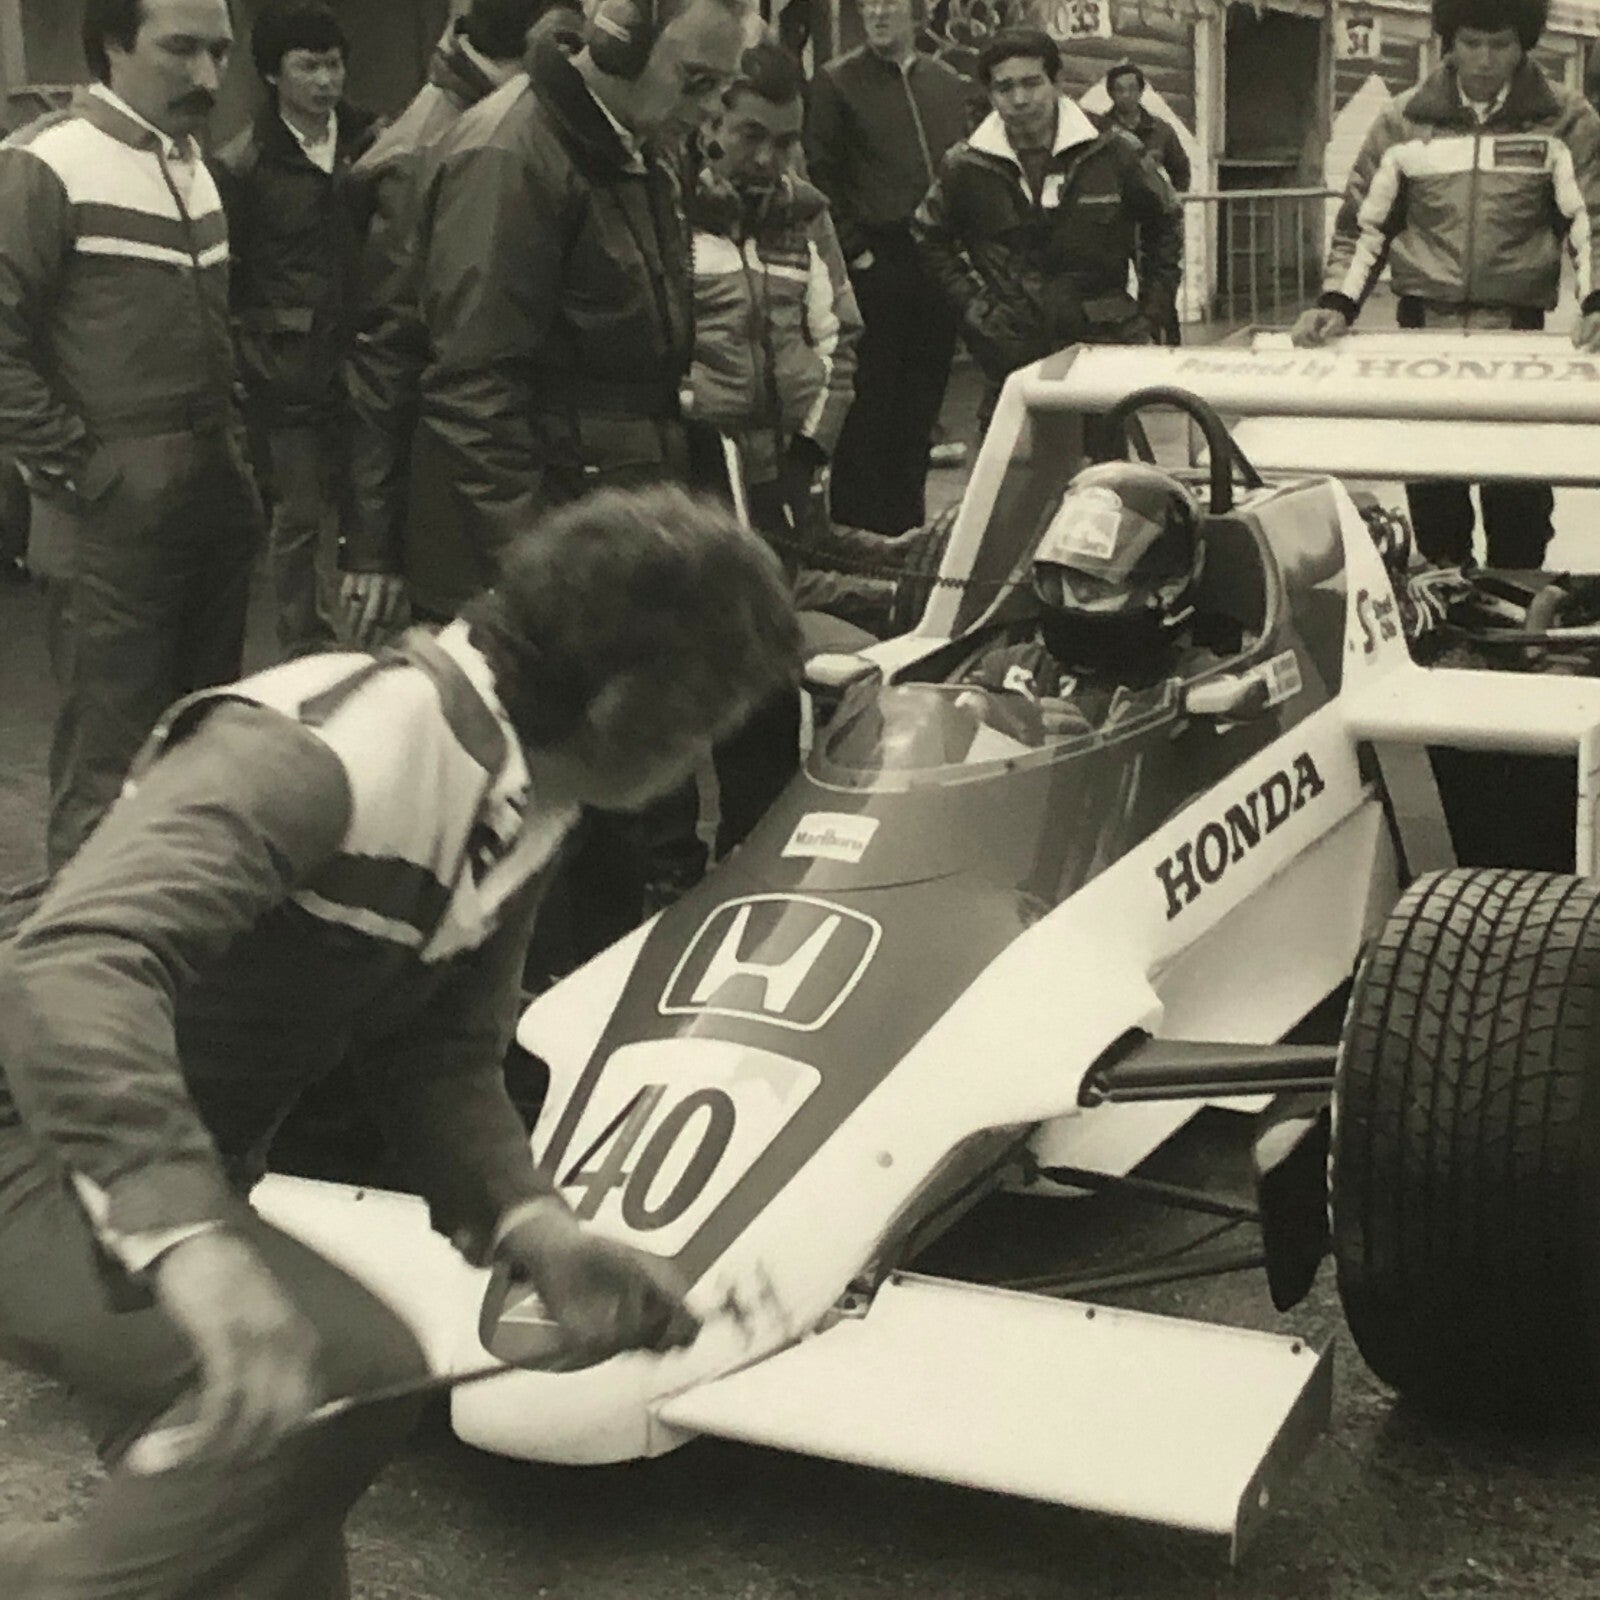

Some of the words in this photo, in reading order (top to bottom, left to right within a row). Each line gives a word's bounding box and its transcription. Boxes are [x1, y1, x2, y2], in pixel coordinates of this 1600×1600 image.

[1354, 358, 1600, 382] HONDA
[1155, 752, 1325, 921] HONDA
[560, 1083, 737, 1232] 40
